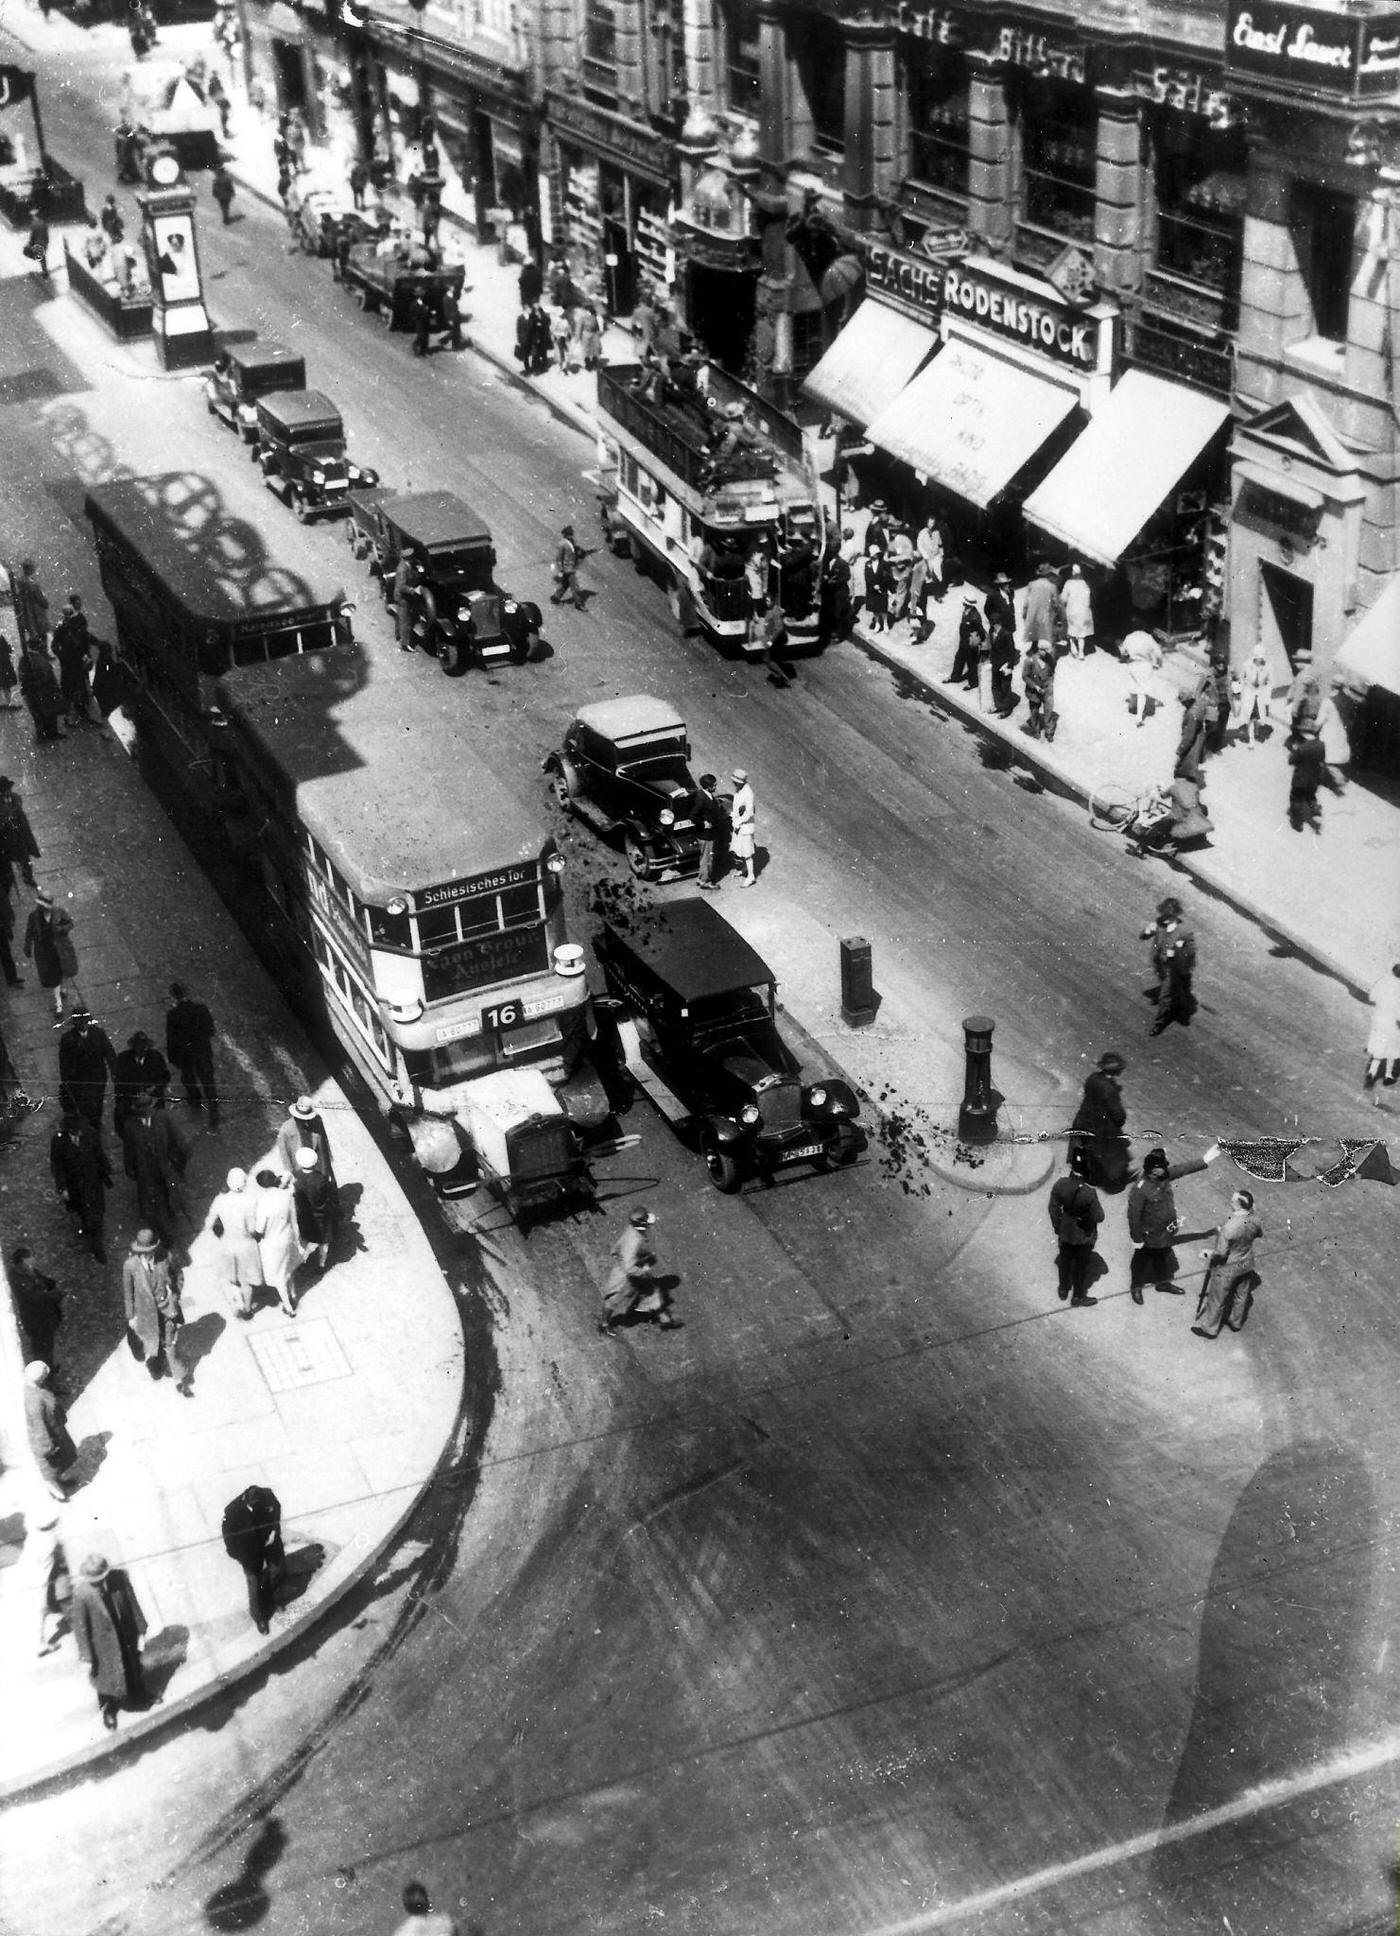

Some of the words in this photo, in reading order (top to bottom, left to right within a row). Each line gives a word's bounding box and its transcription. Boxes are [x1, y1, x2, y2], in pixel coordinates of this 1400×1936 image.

[869, 247, 940, 305] SACHS
[943, 268, 1091, 362] RODENSTOCK
[425, 876, 506, 904] Schlesisches
[508, 869, 526, 883] Tor
[488, 1005, 517, 1028] 16
